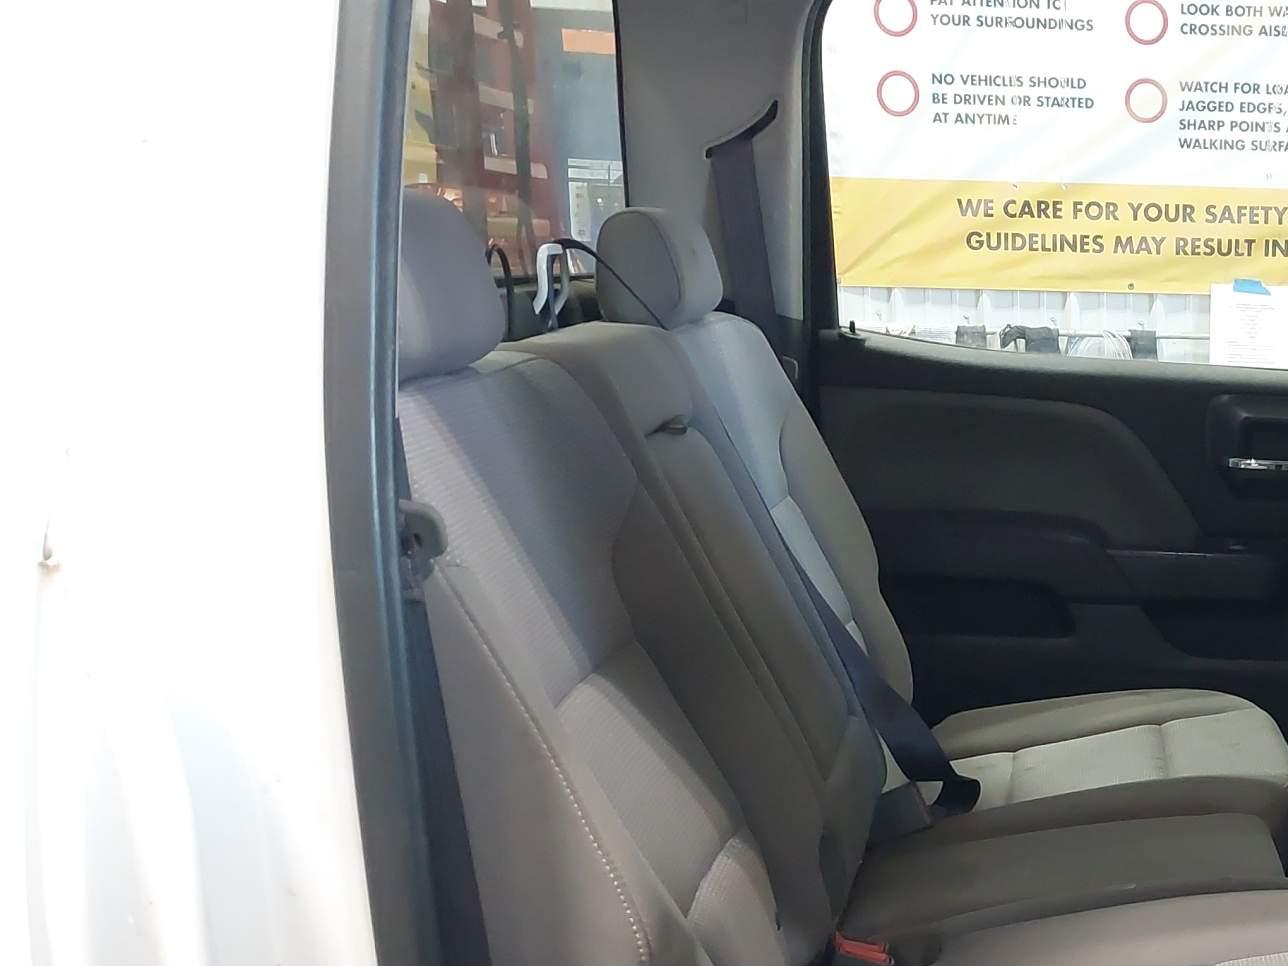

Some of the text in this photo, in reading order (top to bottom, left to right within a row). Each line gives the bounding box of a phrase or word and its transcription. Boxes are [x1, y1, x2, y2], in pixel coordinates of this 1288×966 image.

[1180, 3, 1220, 16] LOOK
[1225, 5, 1263, 17] BOTH
[930, 14, 1094, 31] YOUR SURROUNDINGS
[1180, 24, 1253, 36] CROSSING
[932, 73, 1086, 89] NO VEHICLES SHOULD
[1180, 81, 1228, 94] WATCH
[1234, 83, 1260, 95] FOR
[932, 93, 1094, 109] BE DRIVEN OR STARTED
[1179, 100, 1234, 113] JAGGED
[933, 113, 1017, 125] AT ANYTIME
[1179, 119, 1225, 132] SHARP
[1179, 138, 1245, 151] WALKING
[957, 198, 994, 218] WE
[1003, 200, 1063, 219] CARE
[1073, 201, 1119, 221] FOR
[1128, 202, 1196, 224] YOUR
[966, 232, 1104, 253] GUIDELINES
[1113, 236, 1166, 255] MAY
[1175, 237, 1256, 257] RESULT
[1264, 239, 1288, 257] IN
